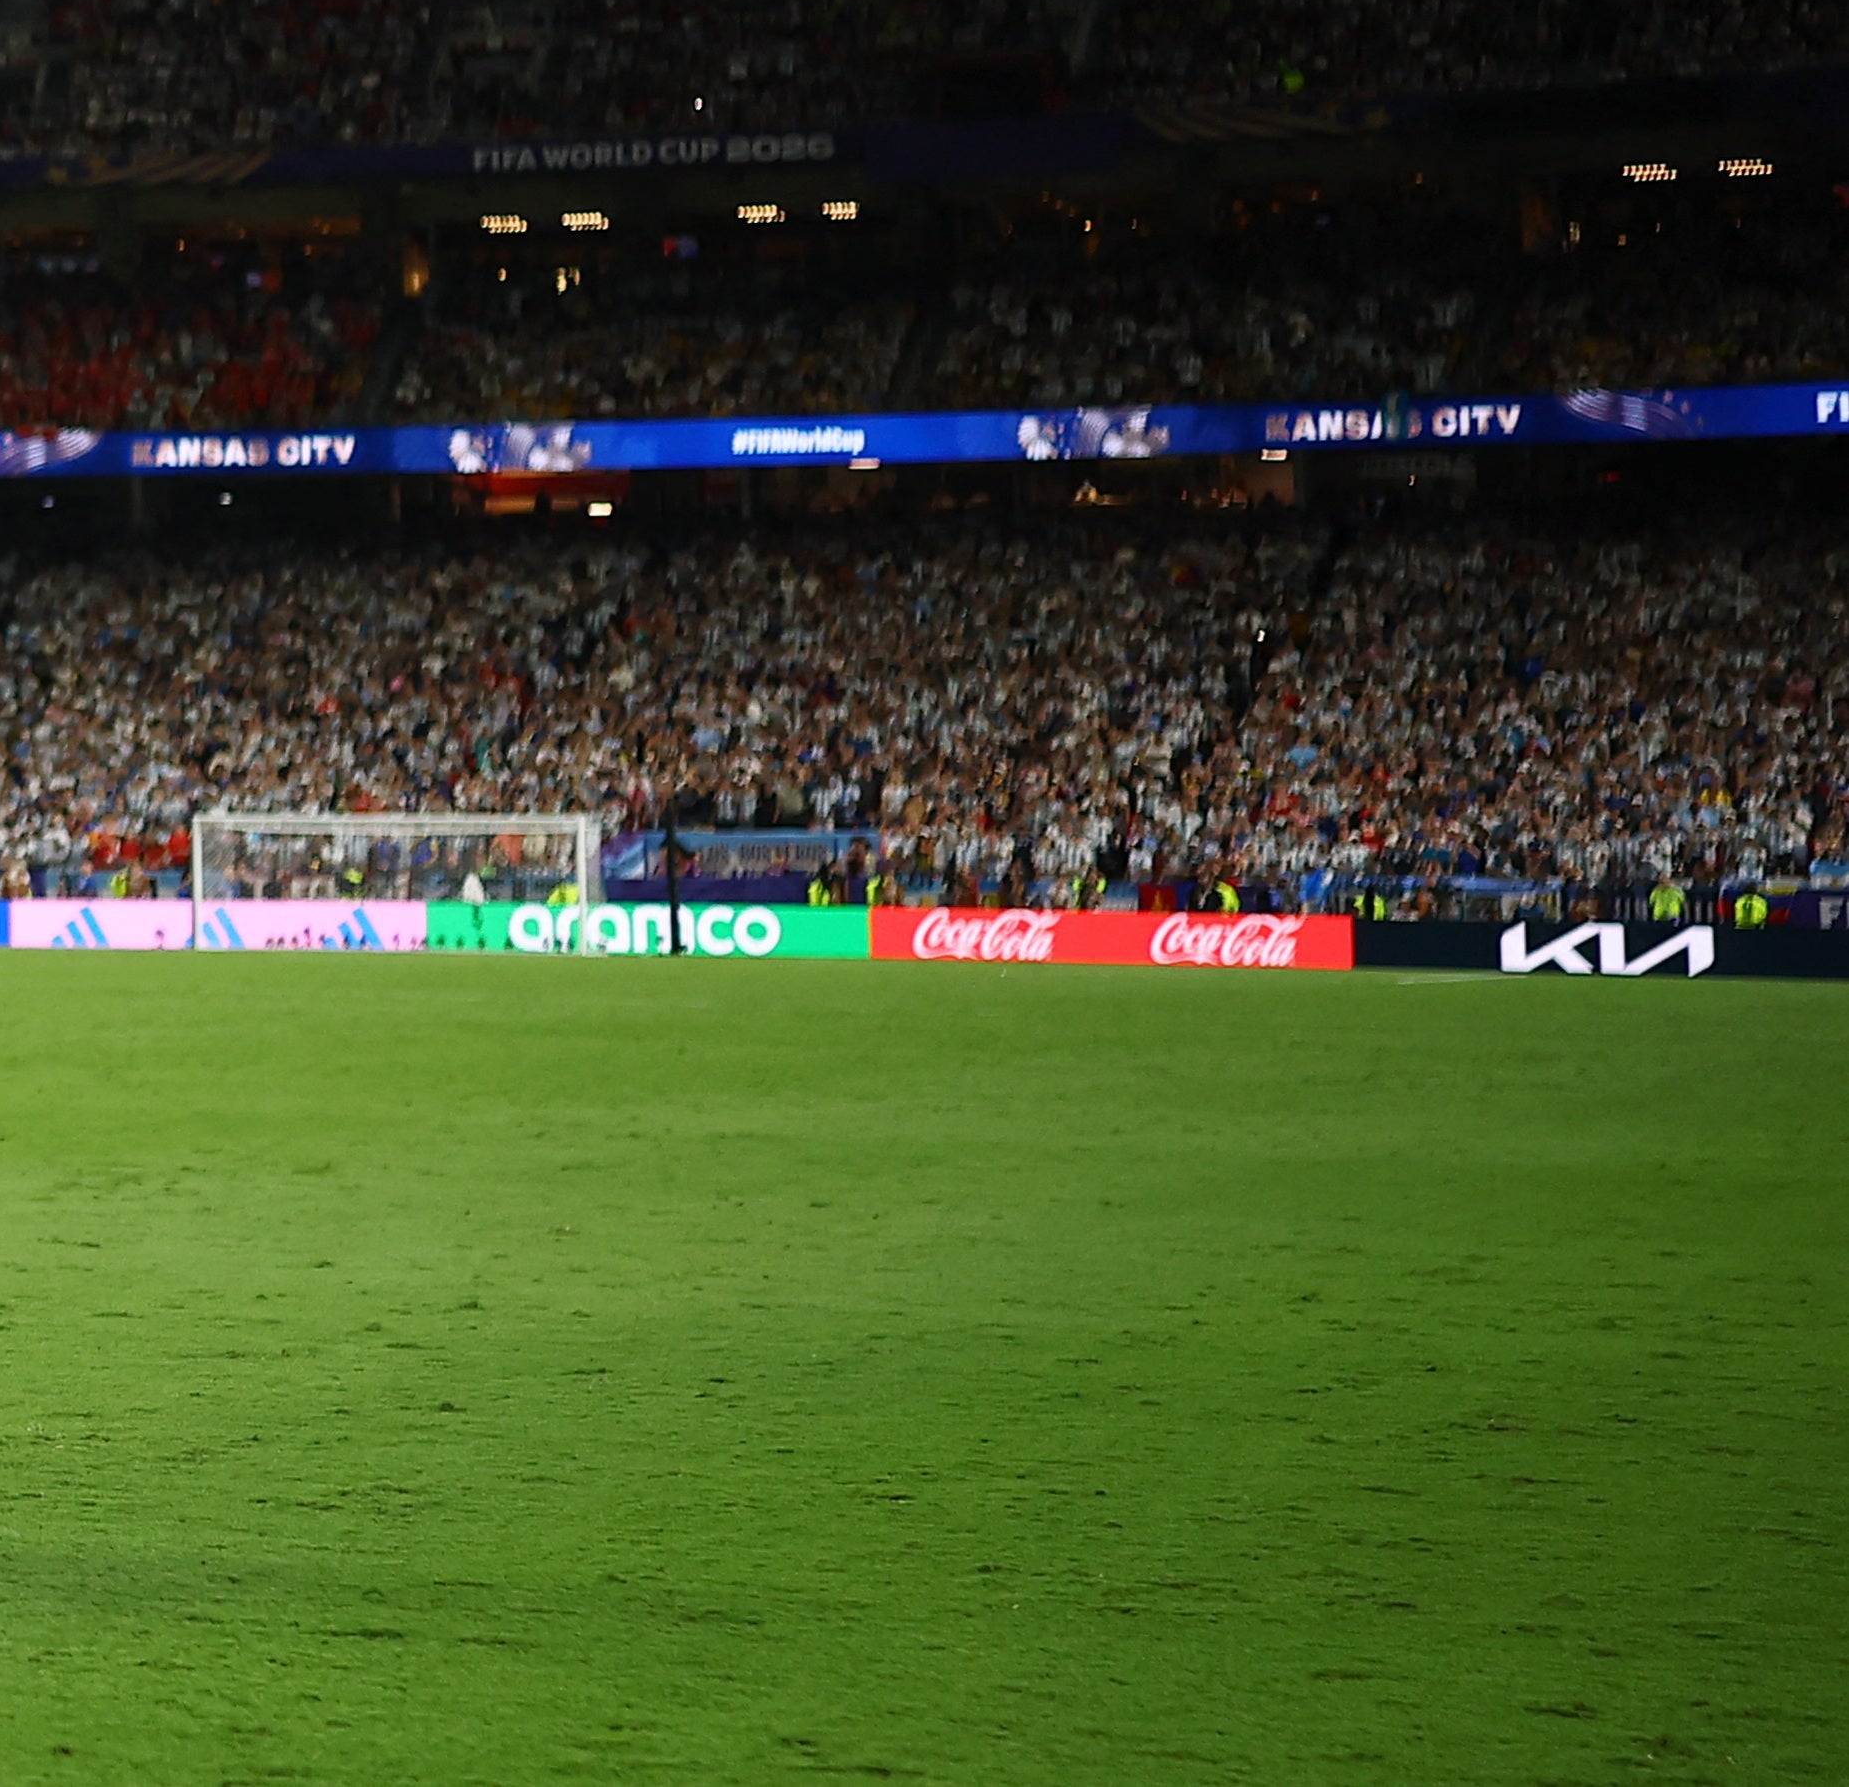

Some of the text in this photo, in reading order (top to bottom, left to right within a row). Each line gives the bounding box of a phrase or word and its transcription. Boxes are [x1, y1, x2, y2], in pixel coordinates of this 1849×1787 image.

[472, 147, 538, 173] FIFA
[542, 139, 653, 170] WORLD
[658, 137, 720, 165] CUP
[1431, 404, 1521, 438] CITY
[277, 434, 356, 466] CITY
[508, 903, 781, 956] aramco
[1819, 897, 1849, 930] F
[1500, 920, 1714, 978] KIA
